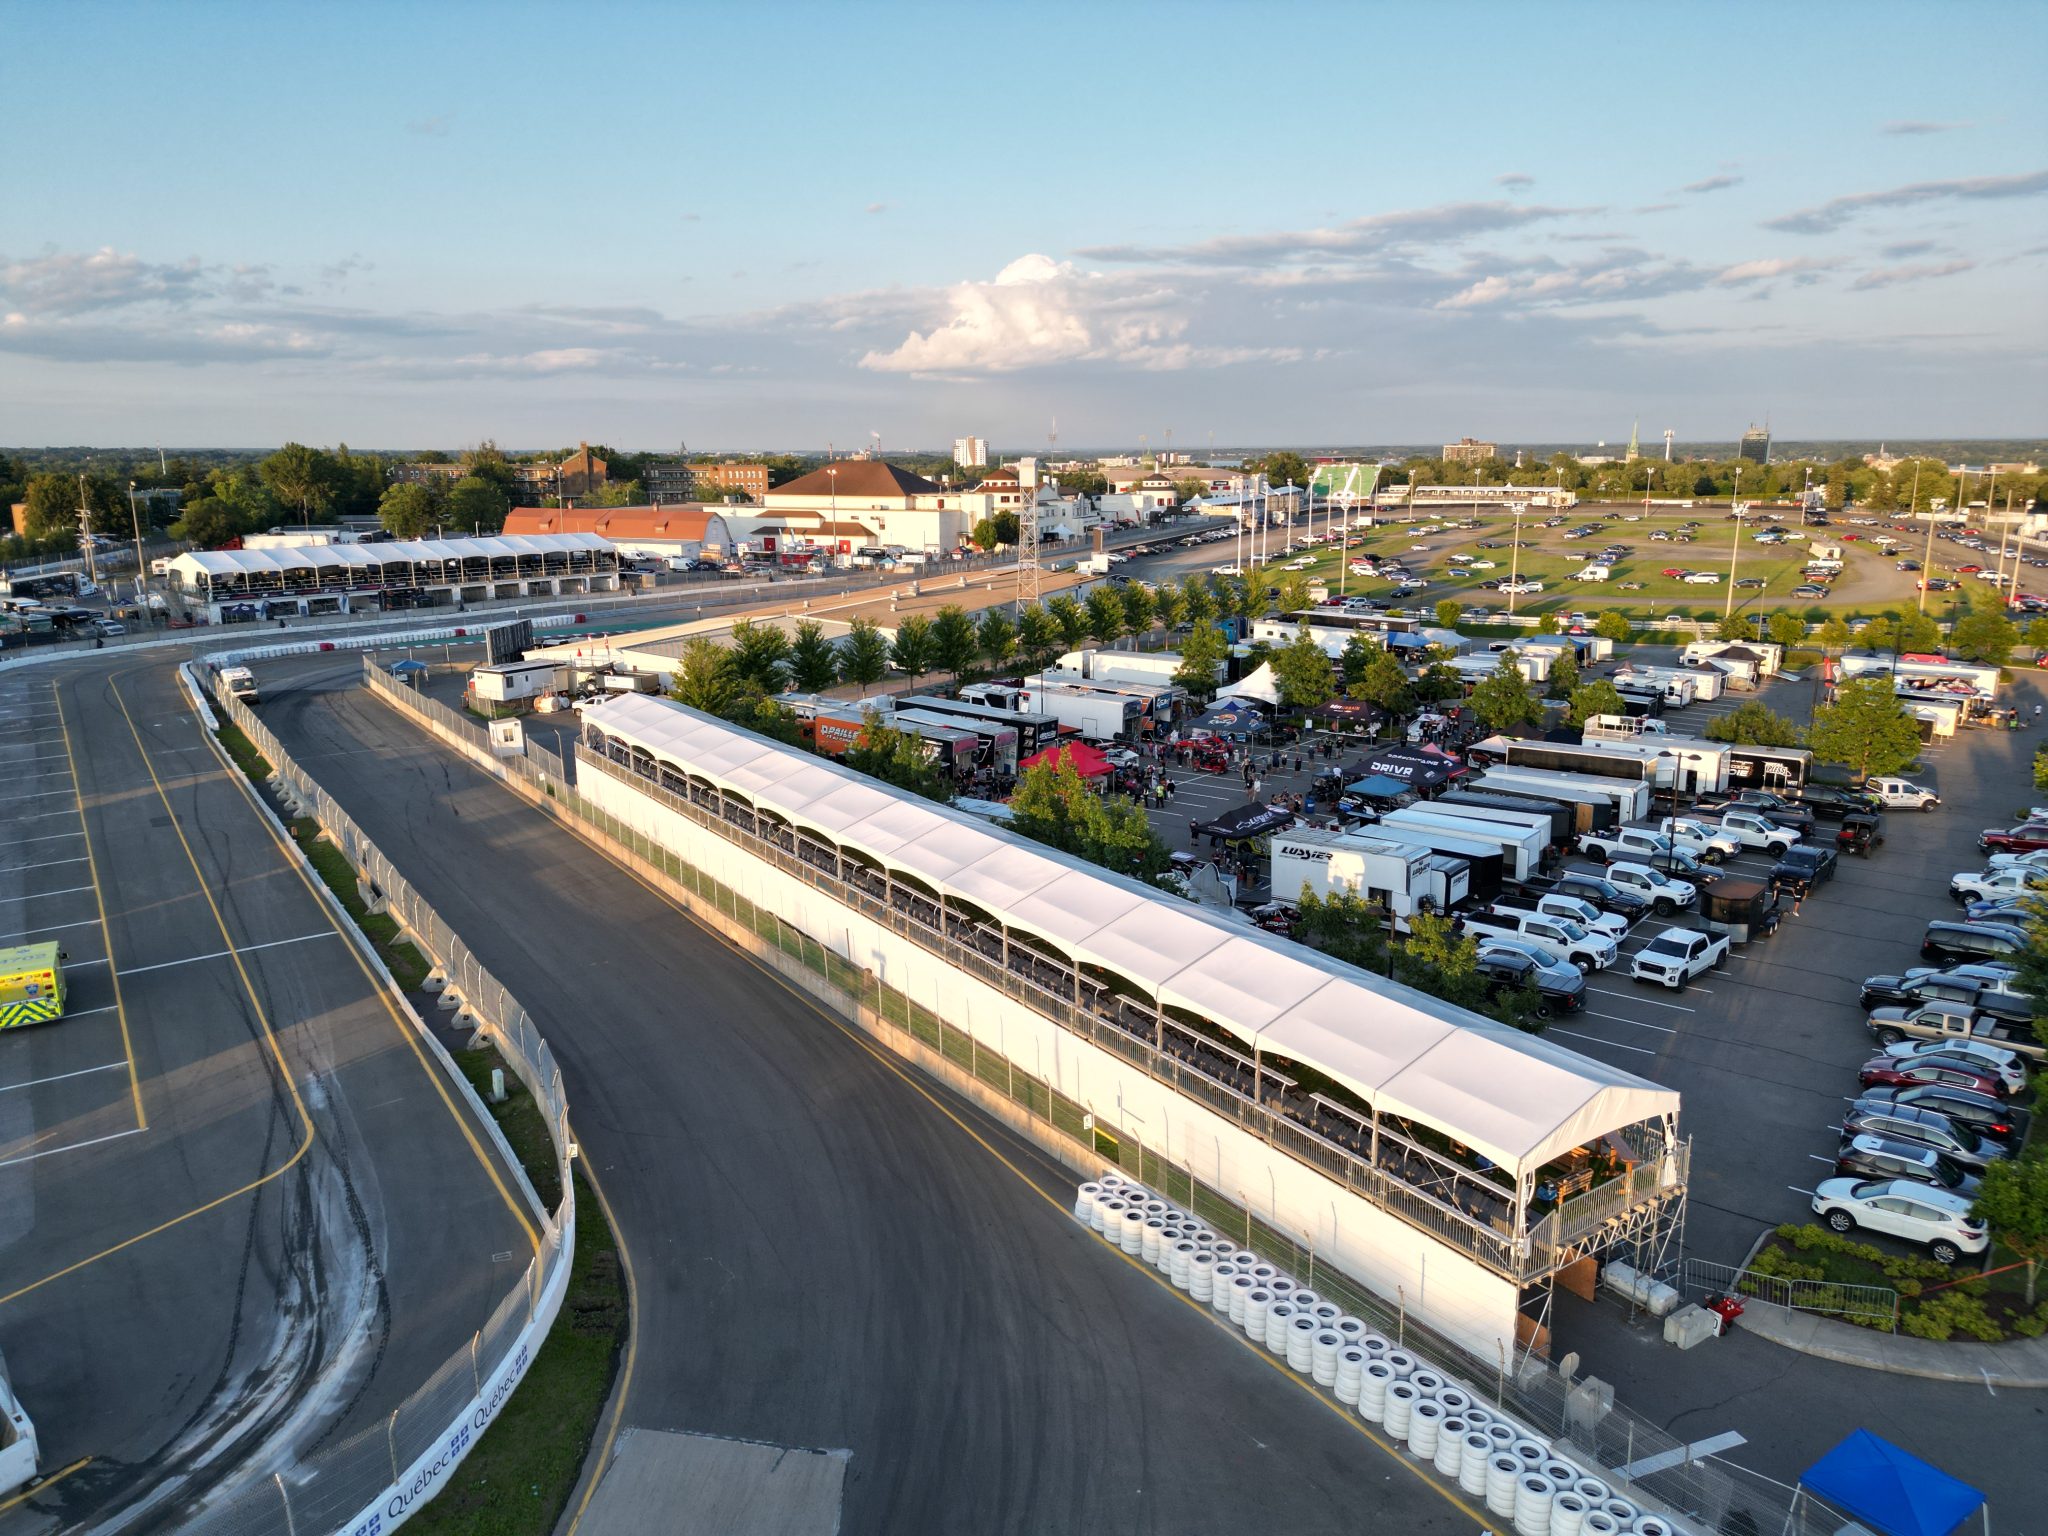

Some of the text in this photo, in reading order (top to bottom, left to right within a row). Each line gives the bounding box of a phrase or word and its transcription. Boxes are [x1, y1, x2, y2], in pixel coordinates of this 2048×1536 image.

[1371, 761, 1413, 776] DRIVR
[1281, 846, 1333, 860] LUSSIER
[474, 1369, 515, 1430] Québec
[388, 1452, 449, 1518] Québec
